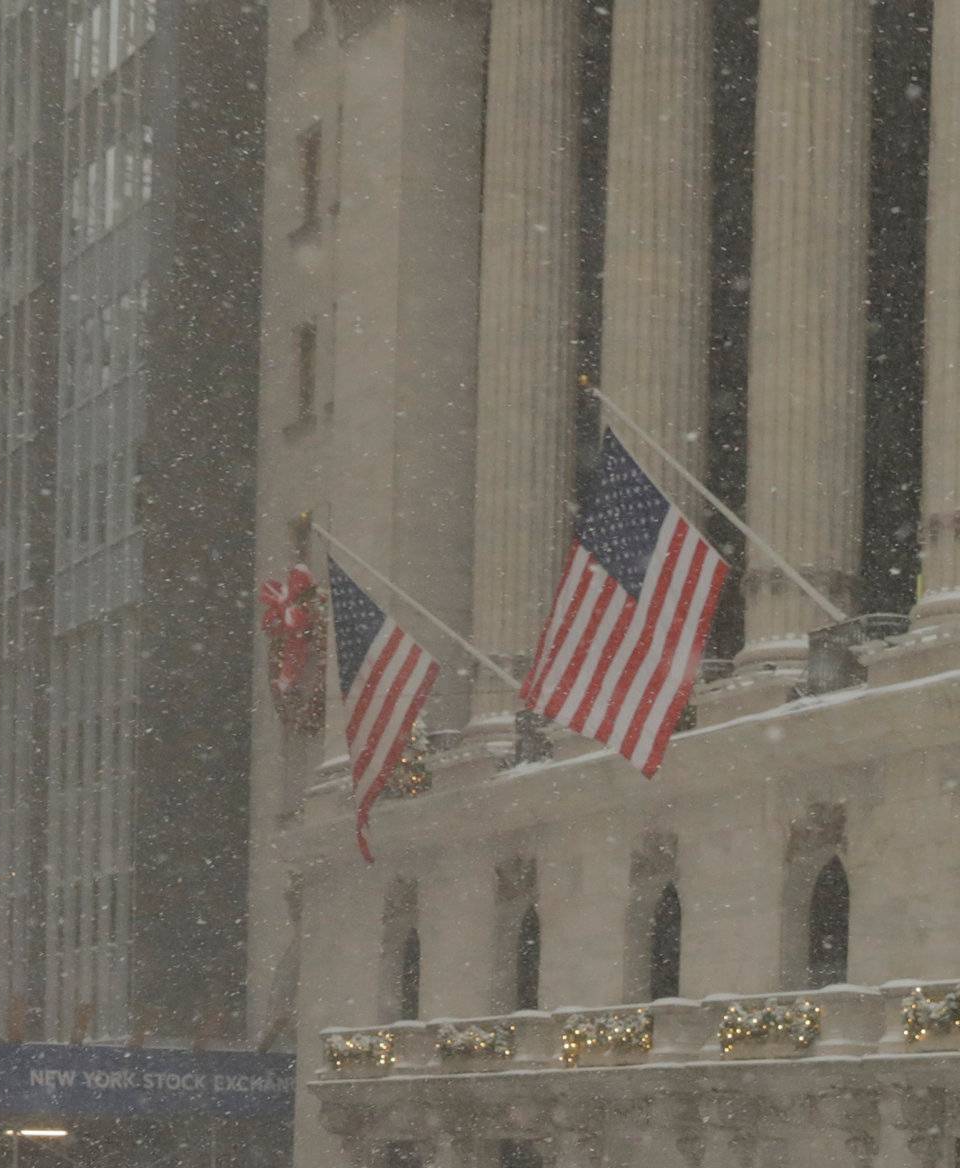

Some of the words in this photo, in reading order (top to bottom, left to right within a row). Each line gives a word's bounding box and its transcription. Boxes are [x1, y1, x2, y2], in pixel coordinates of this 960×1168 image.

[29, 1069, 76, 1088] NEW
[82, 1070, 137, 1089] YORK
[142, 1072, 206, 1091] STOCK
